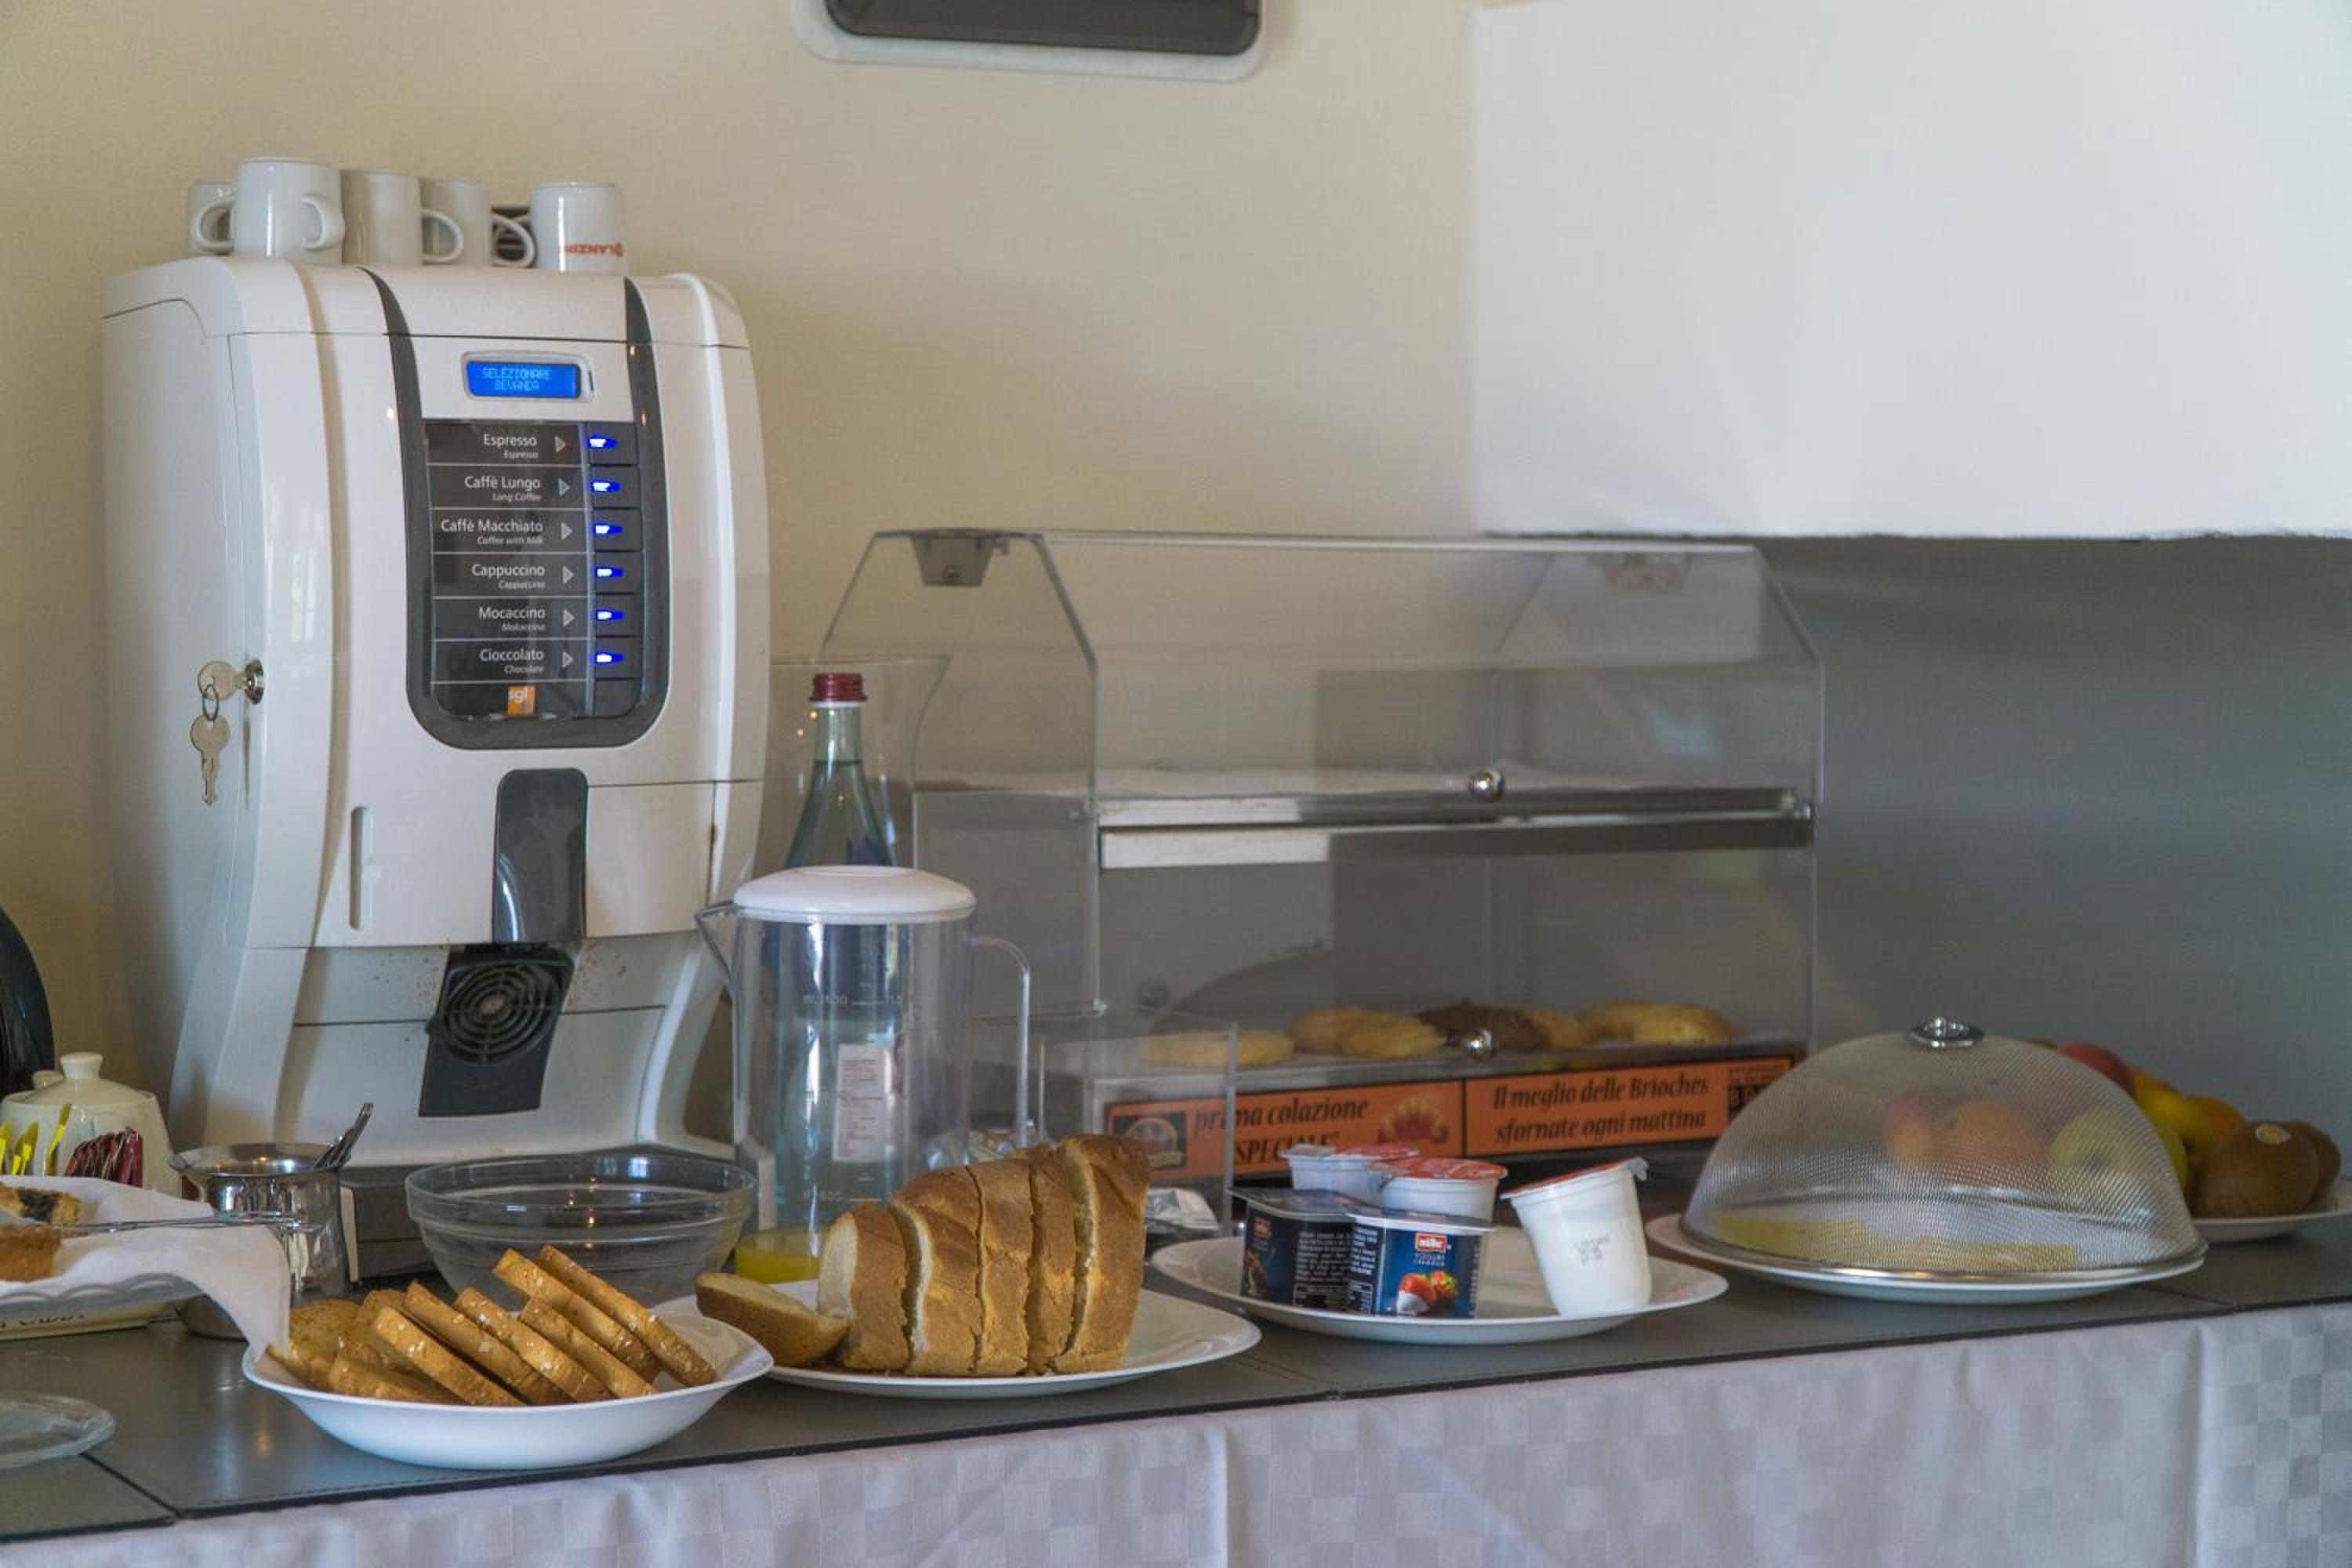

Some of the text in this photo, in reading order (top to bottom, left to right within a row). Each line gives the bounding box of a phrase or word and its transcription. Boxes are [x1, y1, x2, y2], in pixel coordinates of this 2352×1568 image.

[482, 367, 552, 380] SELEZIONARE
[483, 434, 537, 448] Espresso
[464, 474, 541, 492] Caffè Lungo
[441, 517, 543, 532] Caffè Macchiato
[471, 564, 546, 579] Cappuccino
[479, 606, 546, 619] Mocaccino
[479, 648, 545, 662] Cioccolato
[1511, 1081, 1577, 1112] meglio
[1581, 1078, 1625, 1102] delle
[1630, 1072, 1708, 1098] Brioches
[1267, 1098, 1369, 1126] colazione
[1497, 1108, 1707, 1145] sfornate ogni mattina
